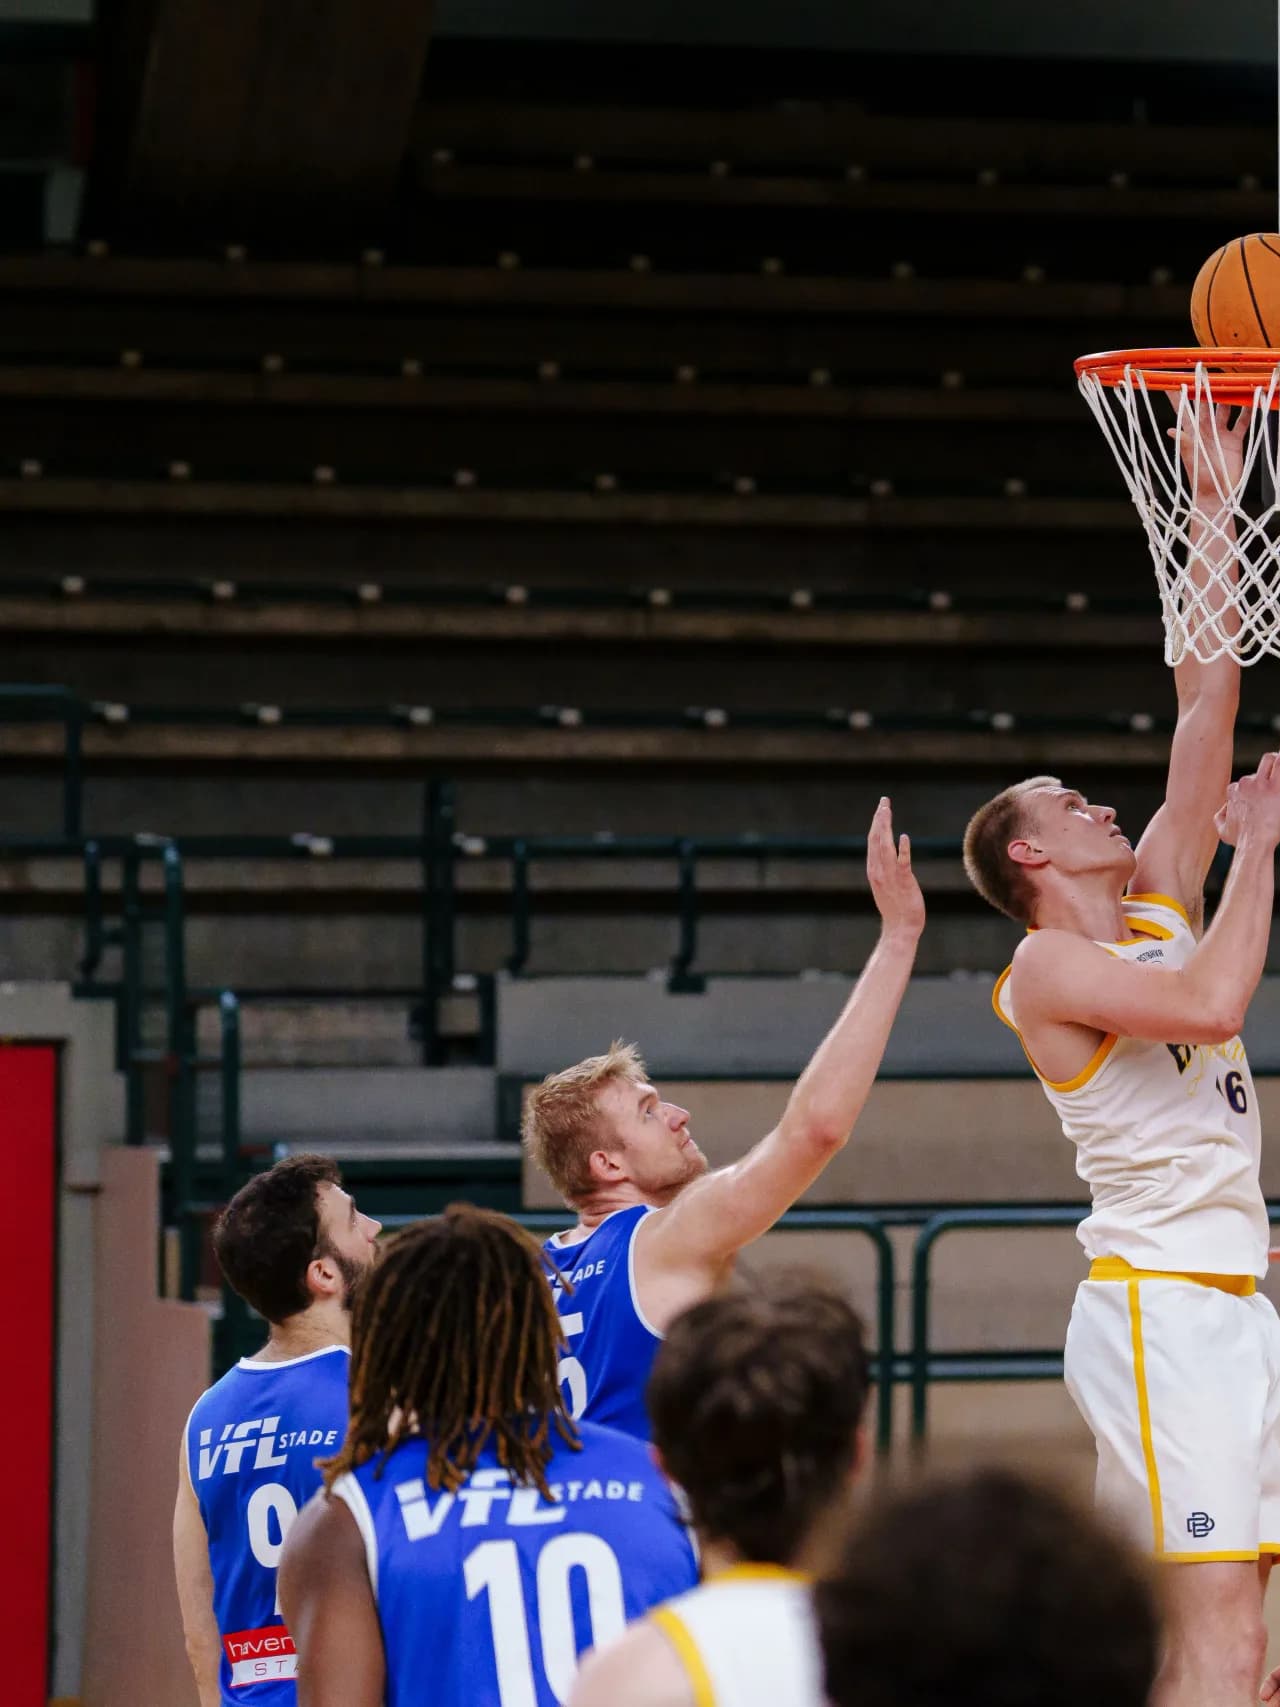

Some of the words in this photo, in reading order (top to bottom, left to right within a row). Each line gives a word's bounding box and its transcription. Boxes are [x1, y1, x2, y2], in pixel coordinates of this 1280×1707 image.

[278, 1430, 339, 1449] STADE
[549, 1479, 644, 1502] STADE
[462, 1532, 627, 1707] 10
